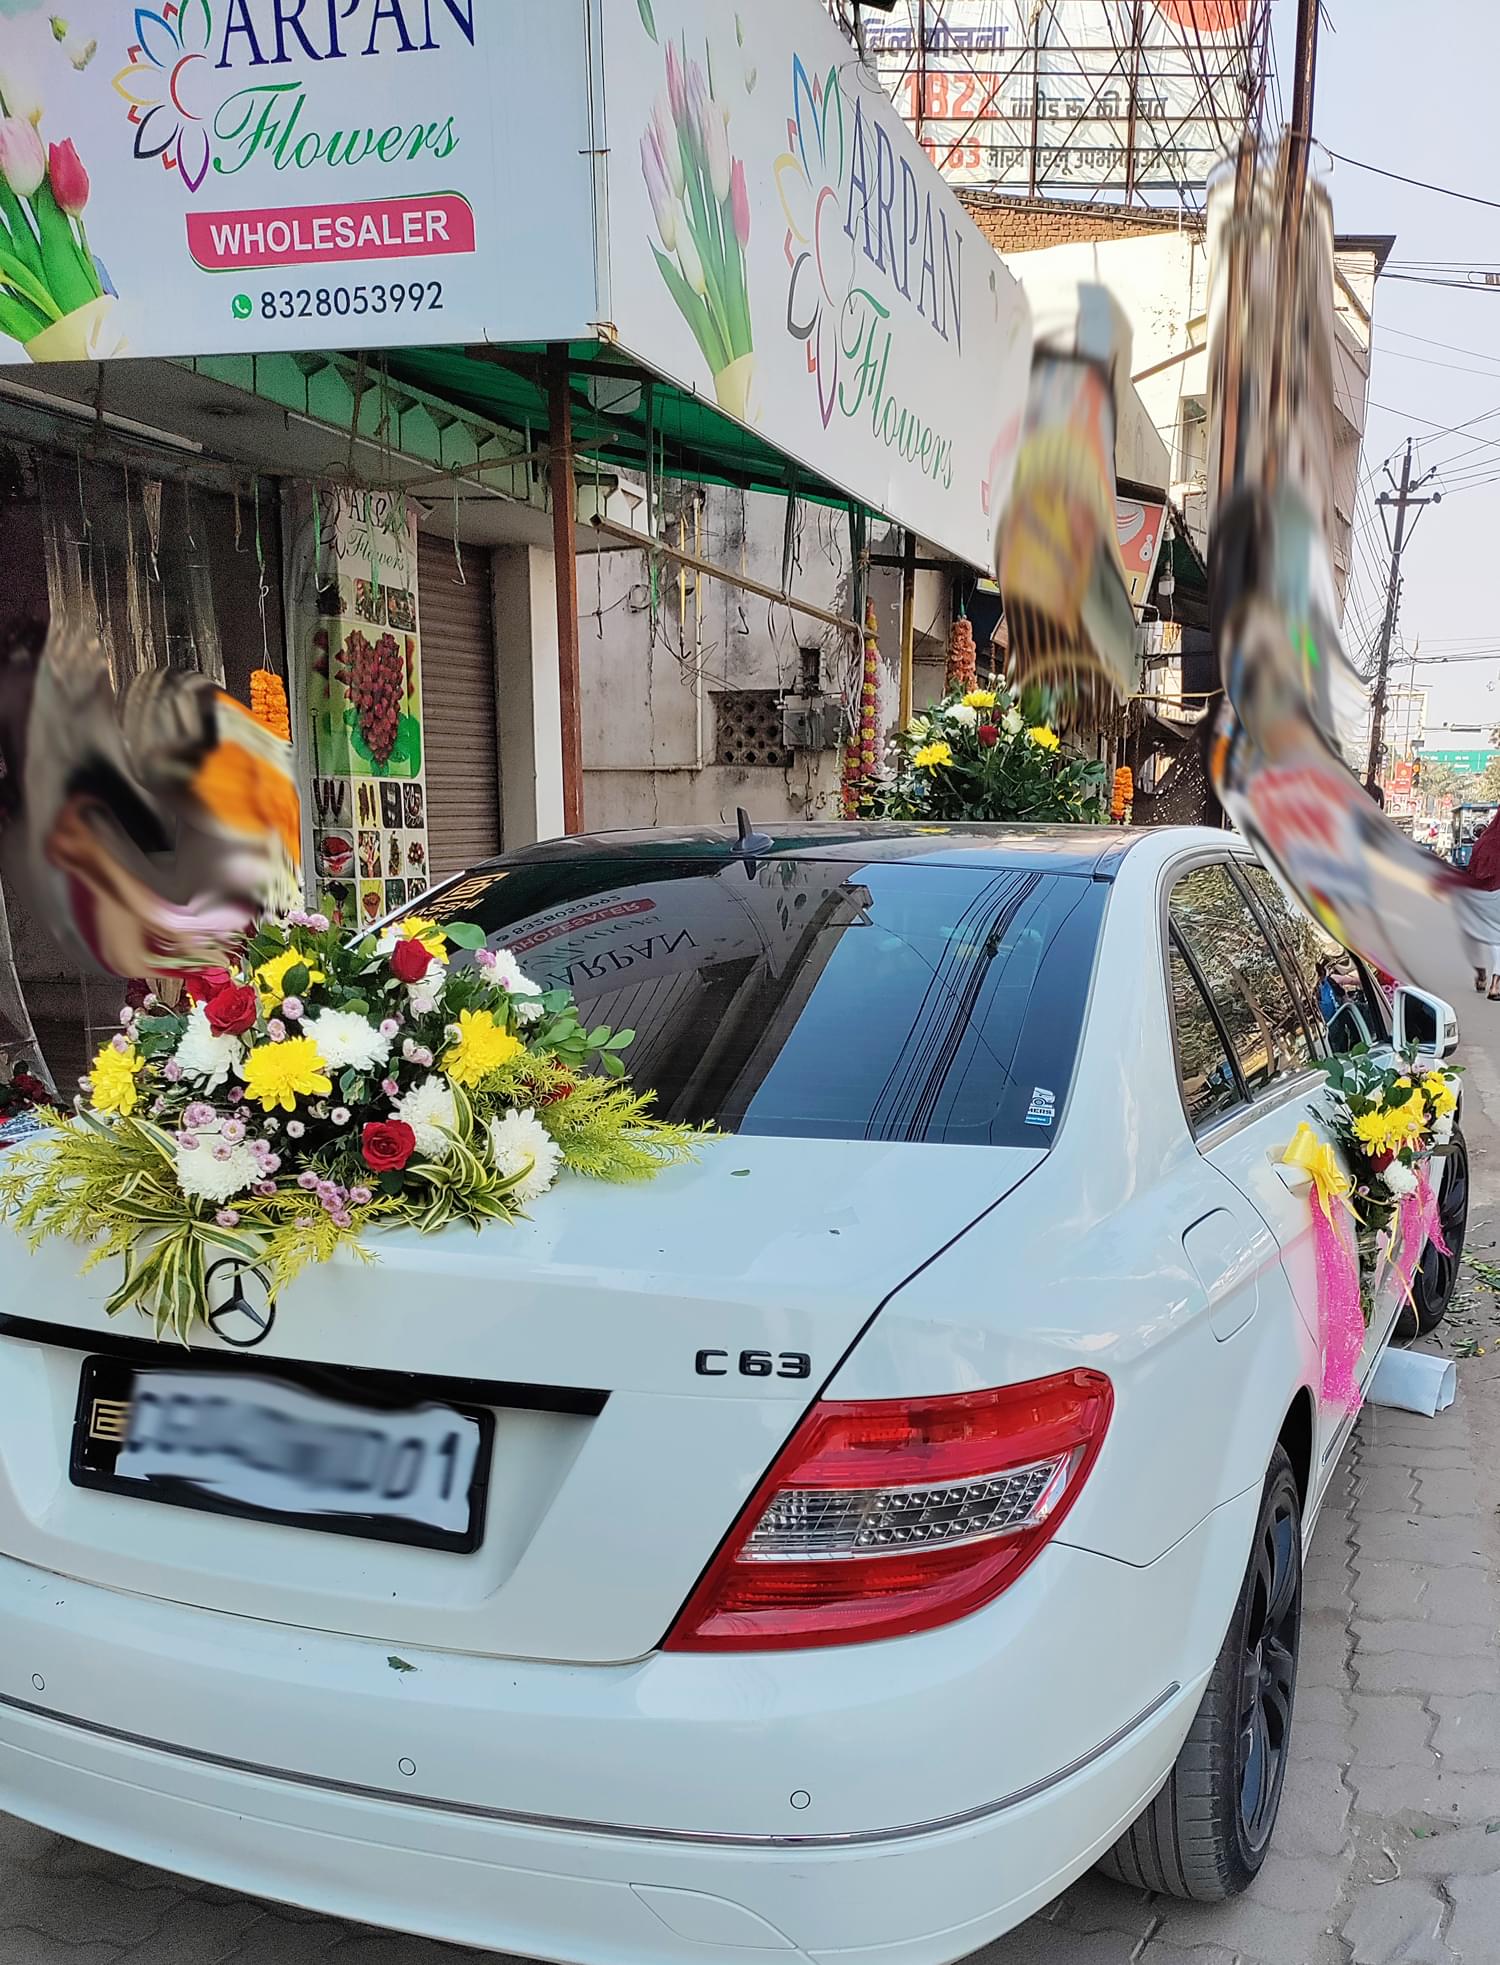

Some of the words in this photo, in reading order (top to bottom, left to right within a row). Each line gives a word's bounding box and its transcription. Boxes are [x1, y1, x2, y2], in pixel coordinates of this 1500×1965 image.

[215, 0, 474, 68] ARPAN
[214, 81, 460, 174] Flowers
[904, 72, 1000, 119] 1822
[210, 209, 450, 256] WHOLESALER
[843, 95, 963, 357] ARPAN
[260, 281, 443, 319] 8328053992
[839, 288, 954, 490] Flowers
